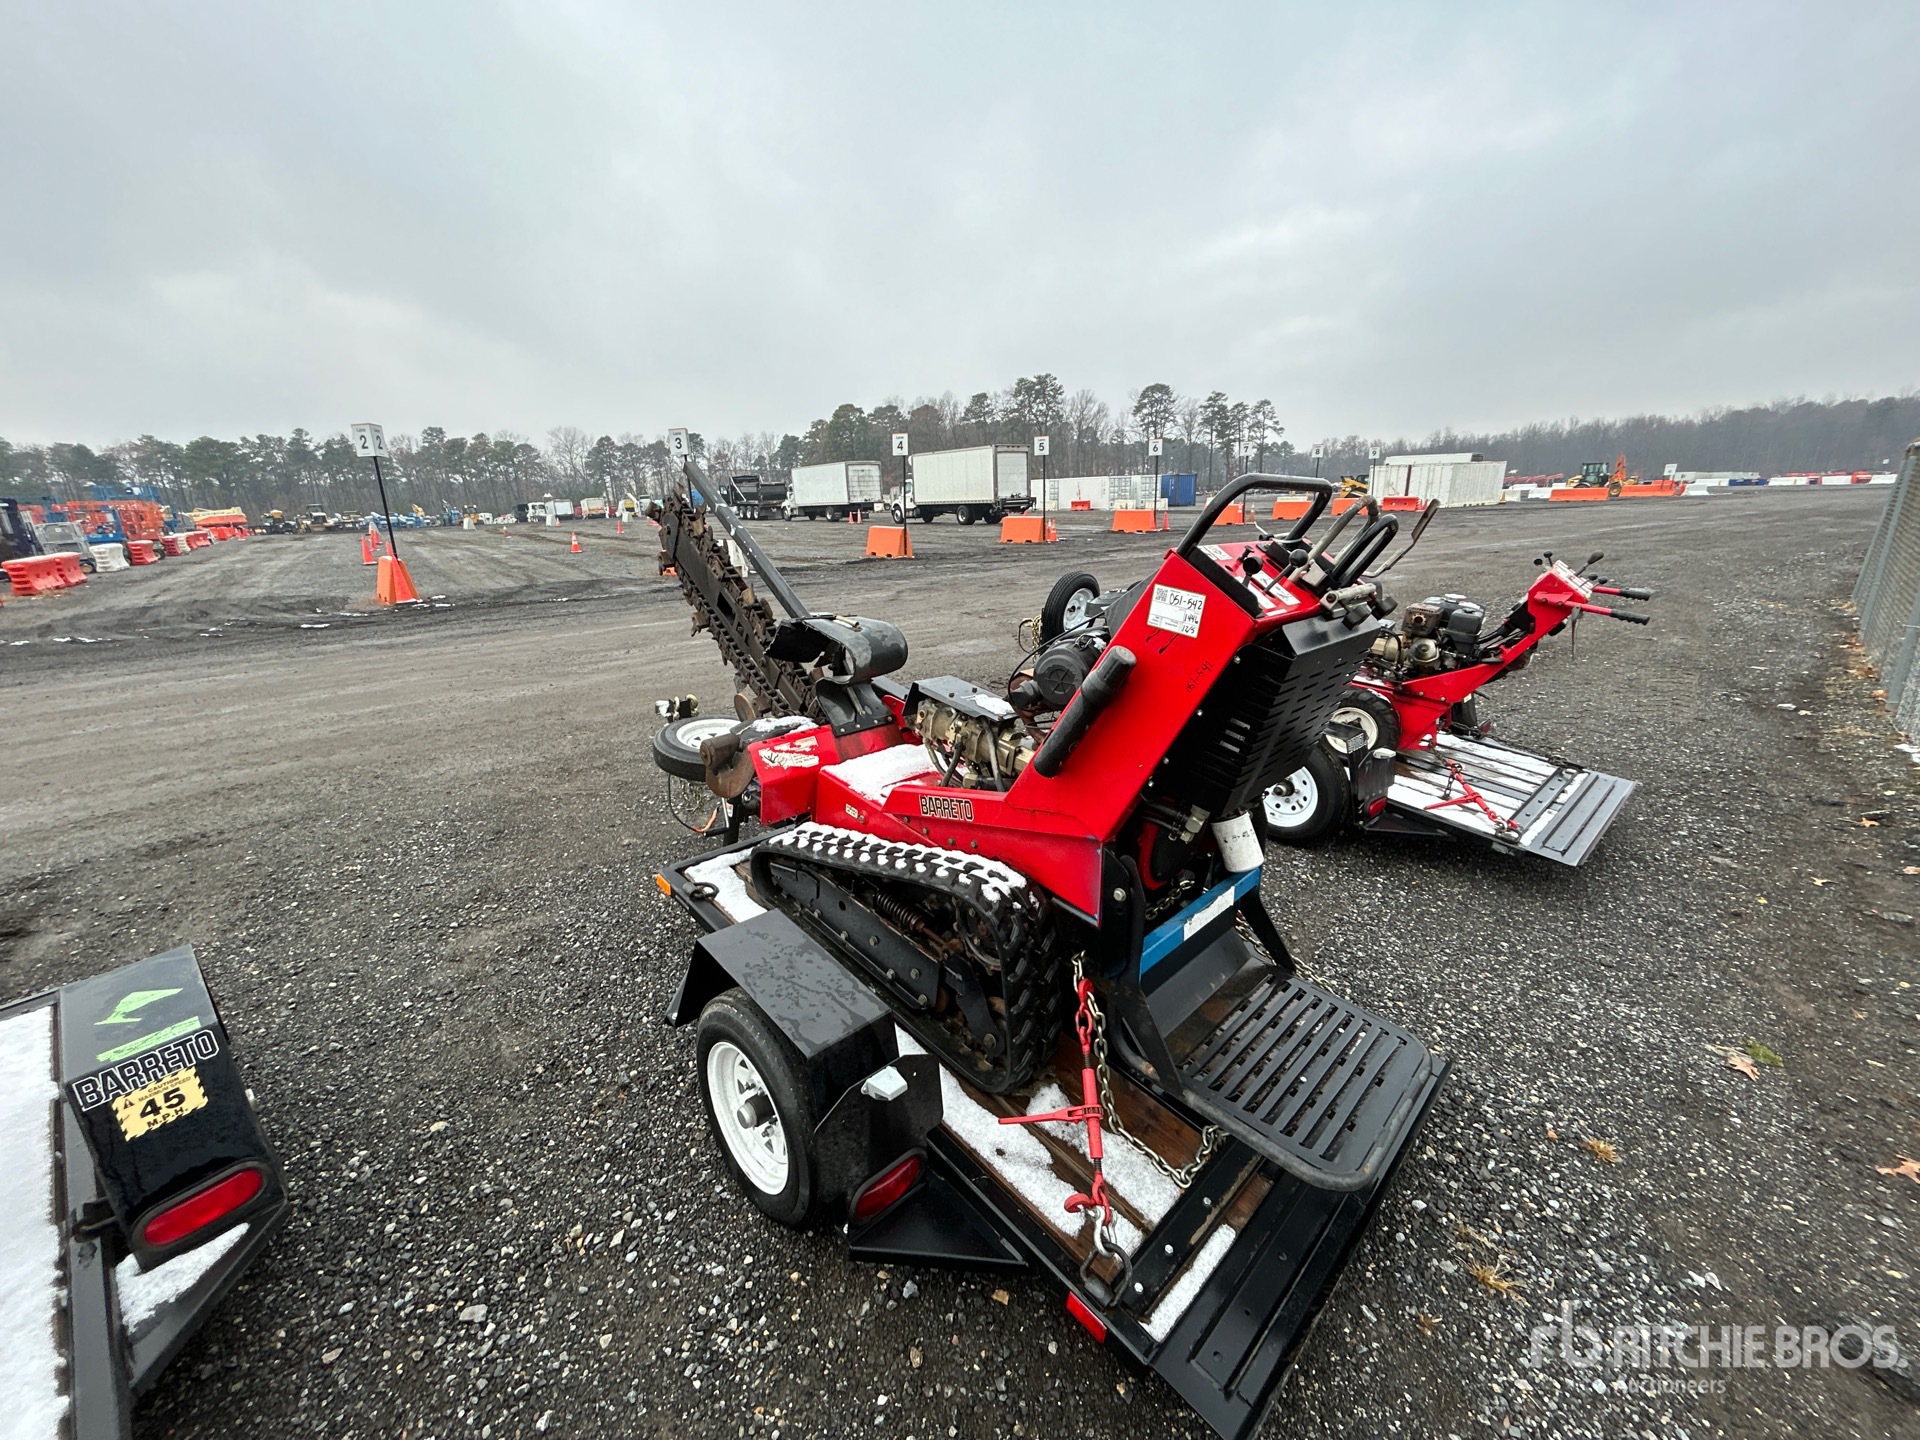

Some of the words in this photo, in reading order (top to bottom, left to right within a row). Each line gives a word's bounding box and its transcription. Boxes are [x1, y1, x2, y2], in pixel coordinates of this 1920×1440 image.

[359, 434, 369, 450] 2
[376, 435, 383, 450] 2
[675, 437, 682, 450] 3
[896, 440, 904, 451] 4
[1038, 442, 1045, 452] 5
[1152, 444, 1159, 452] 6
[1243, 445, 1249, 453] 7
[1169, 592, 1203, 610] 051-542
[918, 794, 974, 821] BARRETO
[72, 1029, 220, 1112] BARRETO
[138, 1086, 169, 1102] MAXIMUM
[170, 1076, 192, 1088] SPEED
[147, 1077, 180, 1093] CAUTION
[140, 1087, 186, 1118] 45
[146, 1106, 189, 1128] M.P.H.
